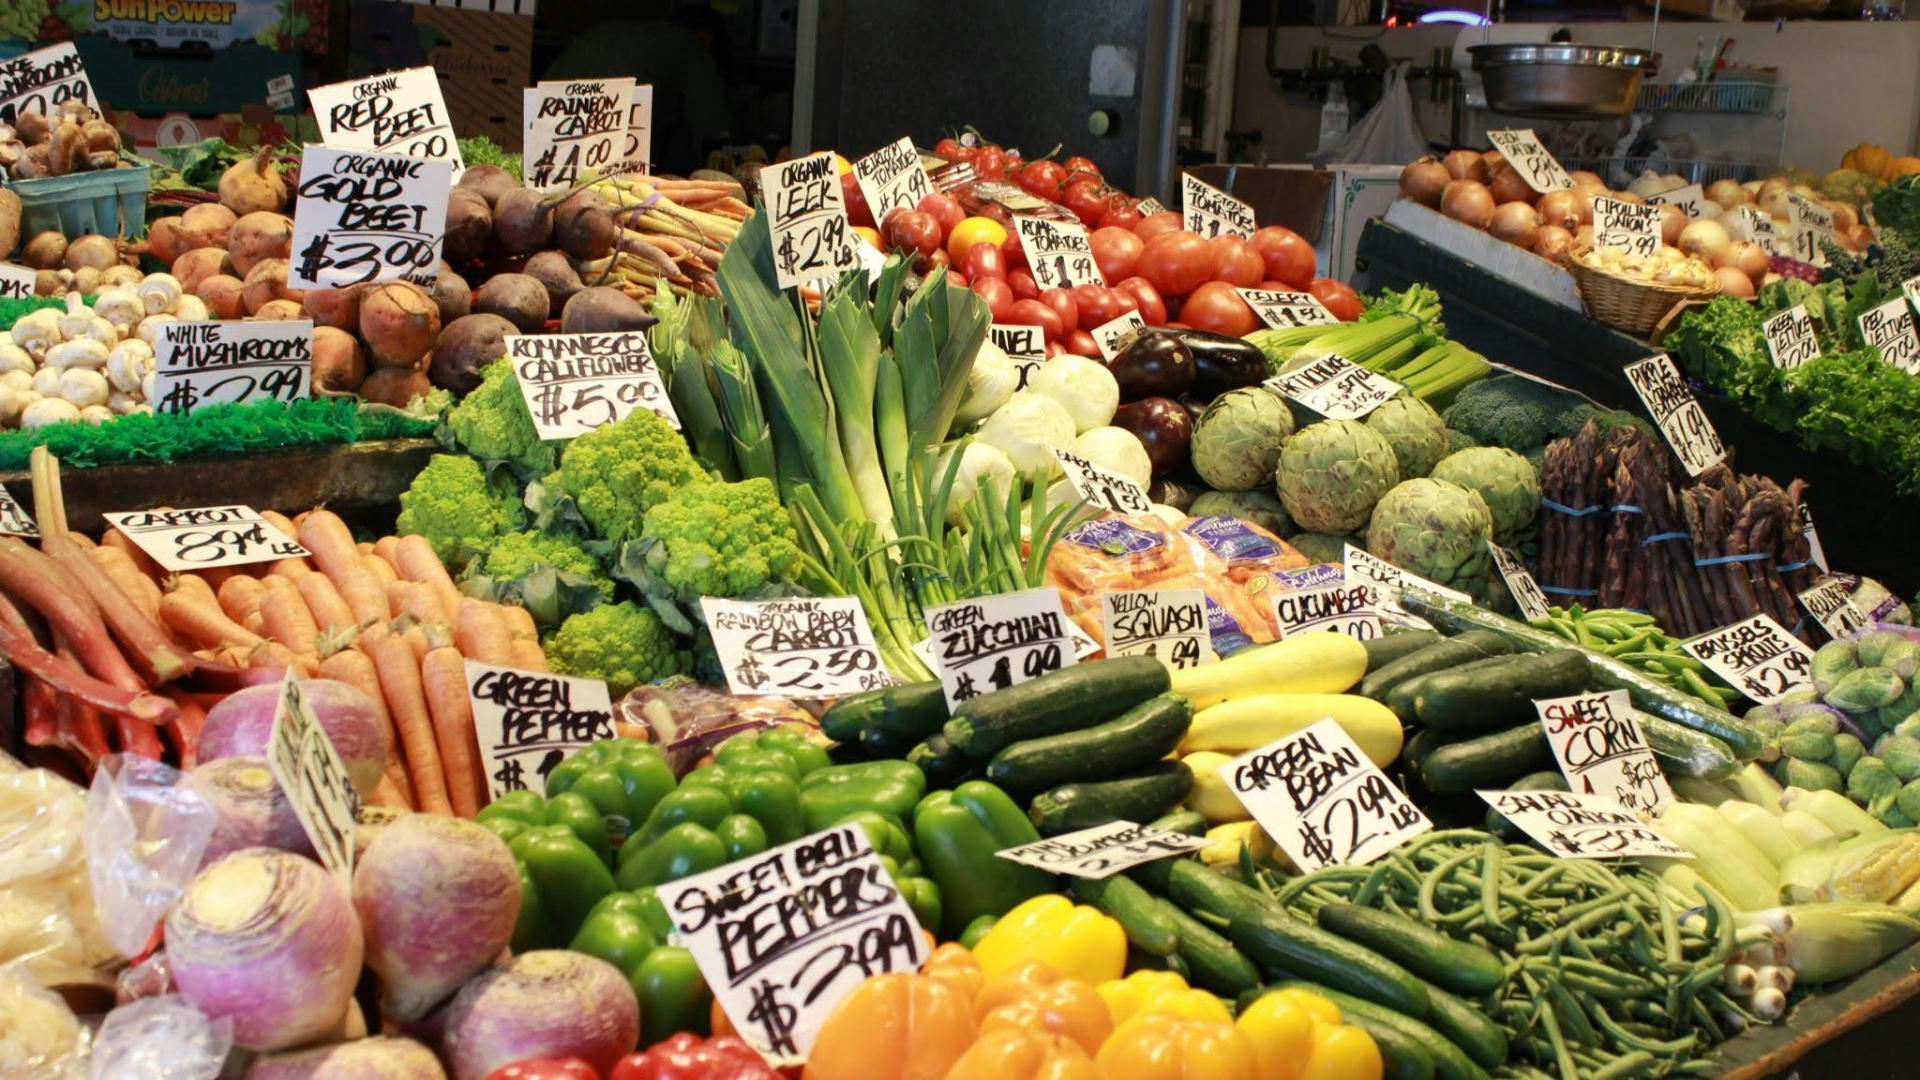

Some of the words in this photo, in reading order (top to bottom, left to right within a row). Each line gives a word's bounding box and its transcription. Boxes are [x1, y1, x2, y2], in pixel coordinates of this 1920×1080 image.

[353, 77, 402, 101] ORGANIC
[565, 82, 606, 96] ORGANIC
[330, 96, 394, 133] RED
[537, 93, 620, 119] RAINBOW
[373, 103, 435, 147] BEET
[554, 110, 624, 136] CARROT
[333, 155, 425, 179] ORGANIC
[781, 156, 834, 189] ORGANIC
[872, 152, 917, 188] TOMATOES
[299, 174, 403, 203] GOLD
[775, 180, 839, 223] LEEK
[338, 203, 428, 233] BEET
[1187, 192, 1255, 233] TOMATOES
[1030, 234, 1089, 251] TOMATOES
[1244, 290, 1322, 307] CELERY
[166, 324, 222, 343] WHITE
[1862, 309, 1884, 335] RED
[168, 337, 311, 368] MUSHROOMS
[512, 333, 646, 360] ROMANESCO
[120, 508, 244, 526] CARROT
[1109, 591, 1159, 615] YELLOW
[1278, 584, 1377, 625] CUCUMBER
[716, 612, 798, 631] RAINBOW
[808, 609, 857, 628] BABY
[932, 605, 985, 633] GREEN
[1113, 603, 1204, 641] SQUASH
[745, 627, 860, 651] CARROT
[939, 611, 1064, 659] ZUCCHINI
[1692, 619, 1774, 660] BRUSSELS
[1722, 633, 1790, 670] SPROUTS
[472, 671, 571, 710] GREEN
[502, 706, 615, 745] PEPPERS
[1544, 695, 1613, 735] SWEET
[1564, 718, 1641, 768] CORN
[1234, 731, 1327, 793] GREEN
[1284, 746, 1361, 813] BEAN
[1389, 803, 1421, 831] LB
[1547, 809, 1637, 826] ONION
[674, 853, 792, 934] SWEET
[794, 828, 875, 878] BELL
[716, 864, 898, 981] PEPPERS
